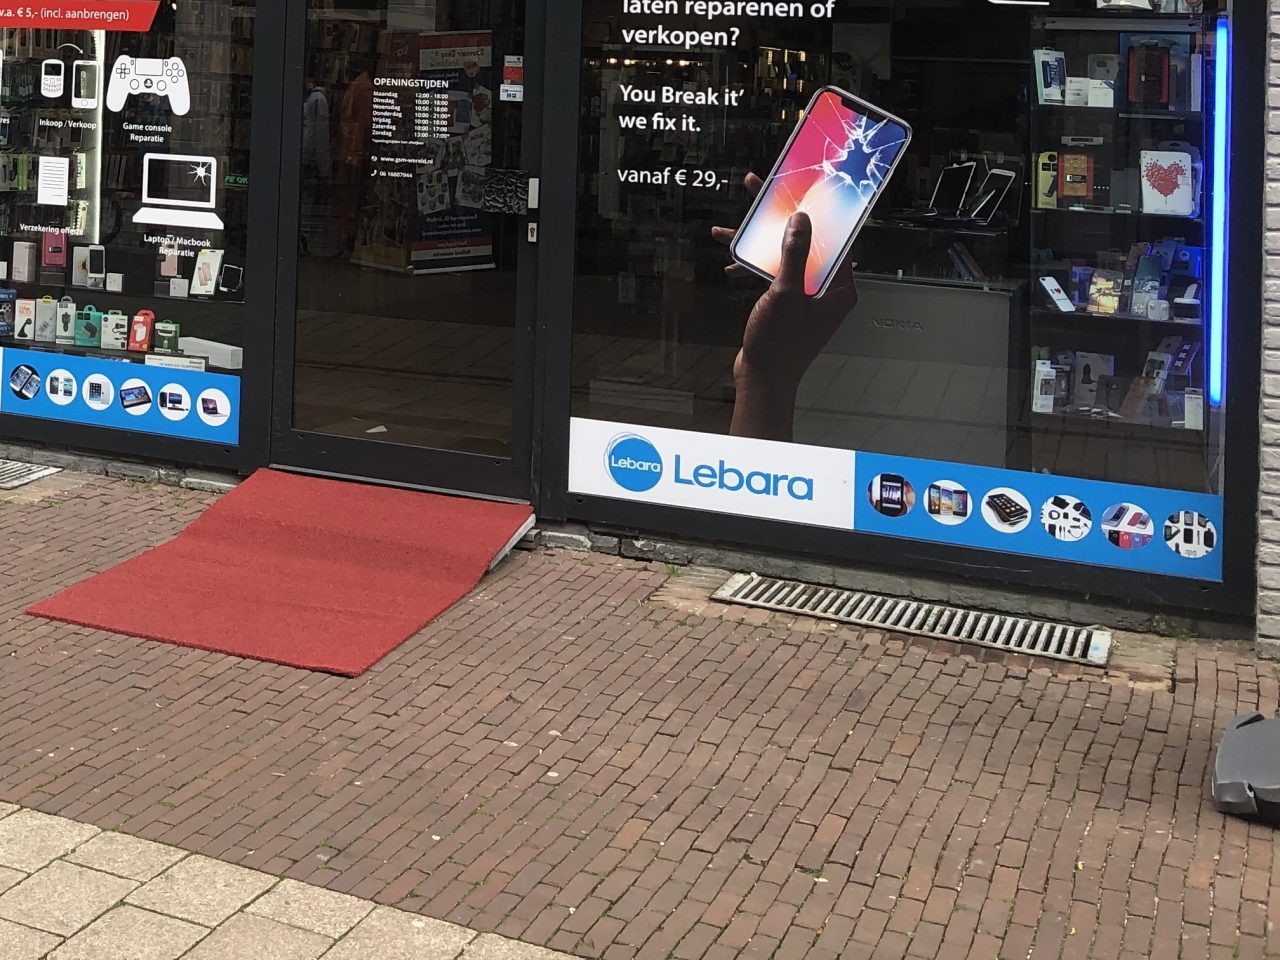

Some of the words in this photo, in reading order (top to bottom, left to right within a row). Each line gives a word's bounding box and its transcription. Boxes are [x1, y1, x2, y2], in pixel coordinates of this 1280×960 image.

[0, 9, 15, 17] v.a.
[17, 8, 24, 18] €
[25, 9, 38, 19] 5,-
[40, 8, 63, 20] (incl.
[65, 9, 130, 22] aanbrengen)
[621, 25, 740, 50] verkopen?
[373, 78, 449, 89] OPENINGSTIJDEN
[620, 85, 656, 103] You
[661, 86, 720, 106] Break
[39, 118, 63, 128] Inkoop
[68, 120, 97, 131] Verkoop
[122, 121, 144, 131] Game
[144, 123, 173, 133] console
[619, 114, 648, 129] we
[651, 112, 677, 131] fix
[681, 113, 702, 133] it.
[130, 133, 164, 143] Reparatie
[617, 167, 672, 185] vanaf
[674, 169, 687, 186] €
[692, 170, 729, 190] 29,-
[20, 223, 60, 235] Verzekering
[143, 234, 170, 244] Laptop
[177, 237, 211, 247] Macbook
[159, 247, 195, 257] Reparatie
[611, 455, 661, 472] Lebara
[674, 454, 814, 501] Lebara
